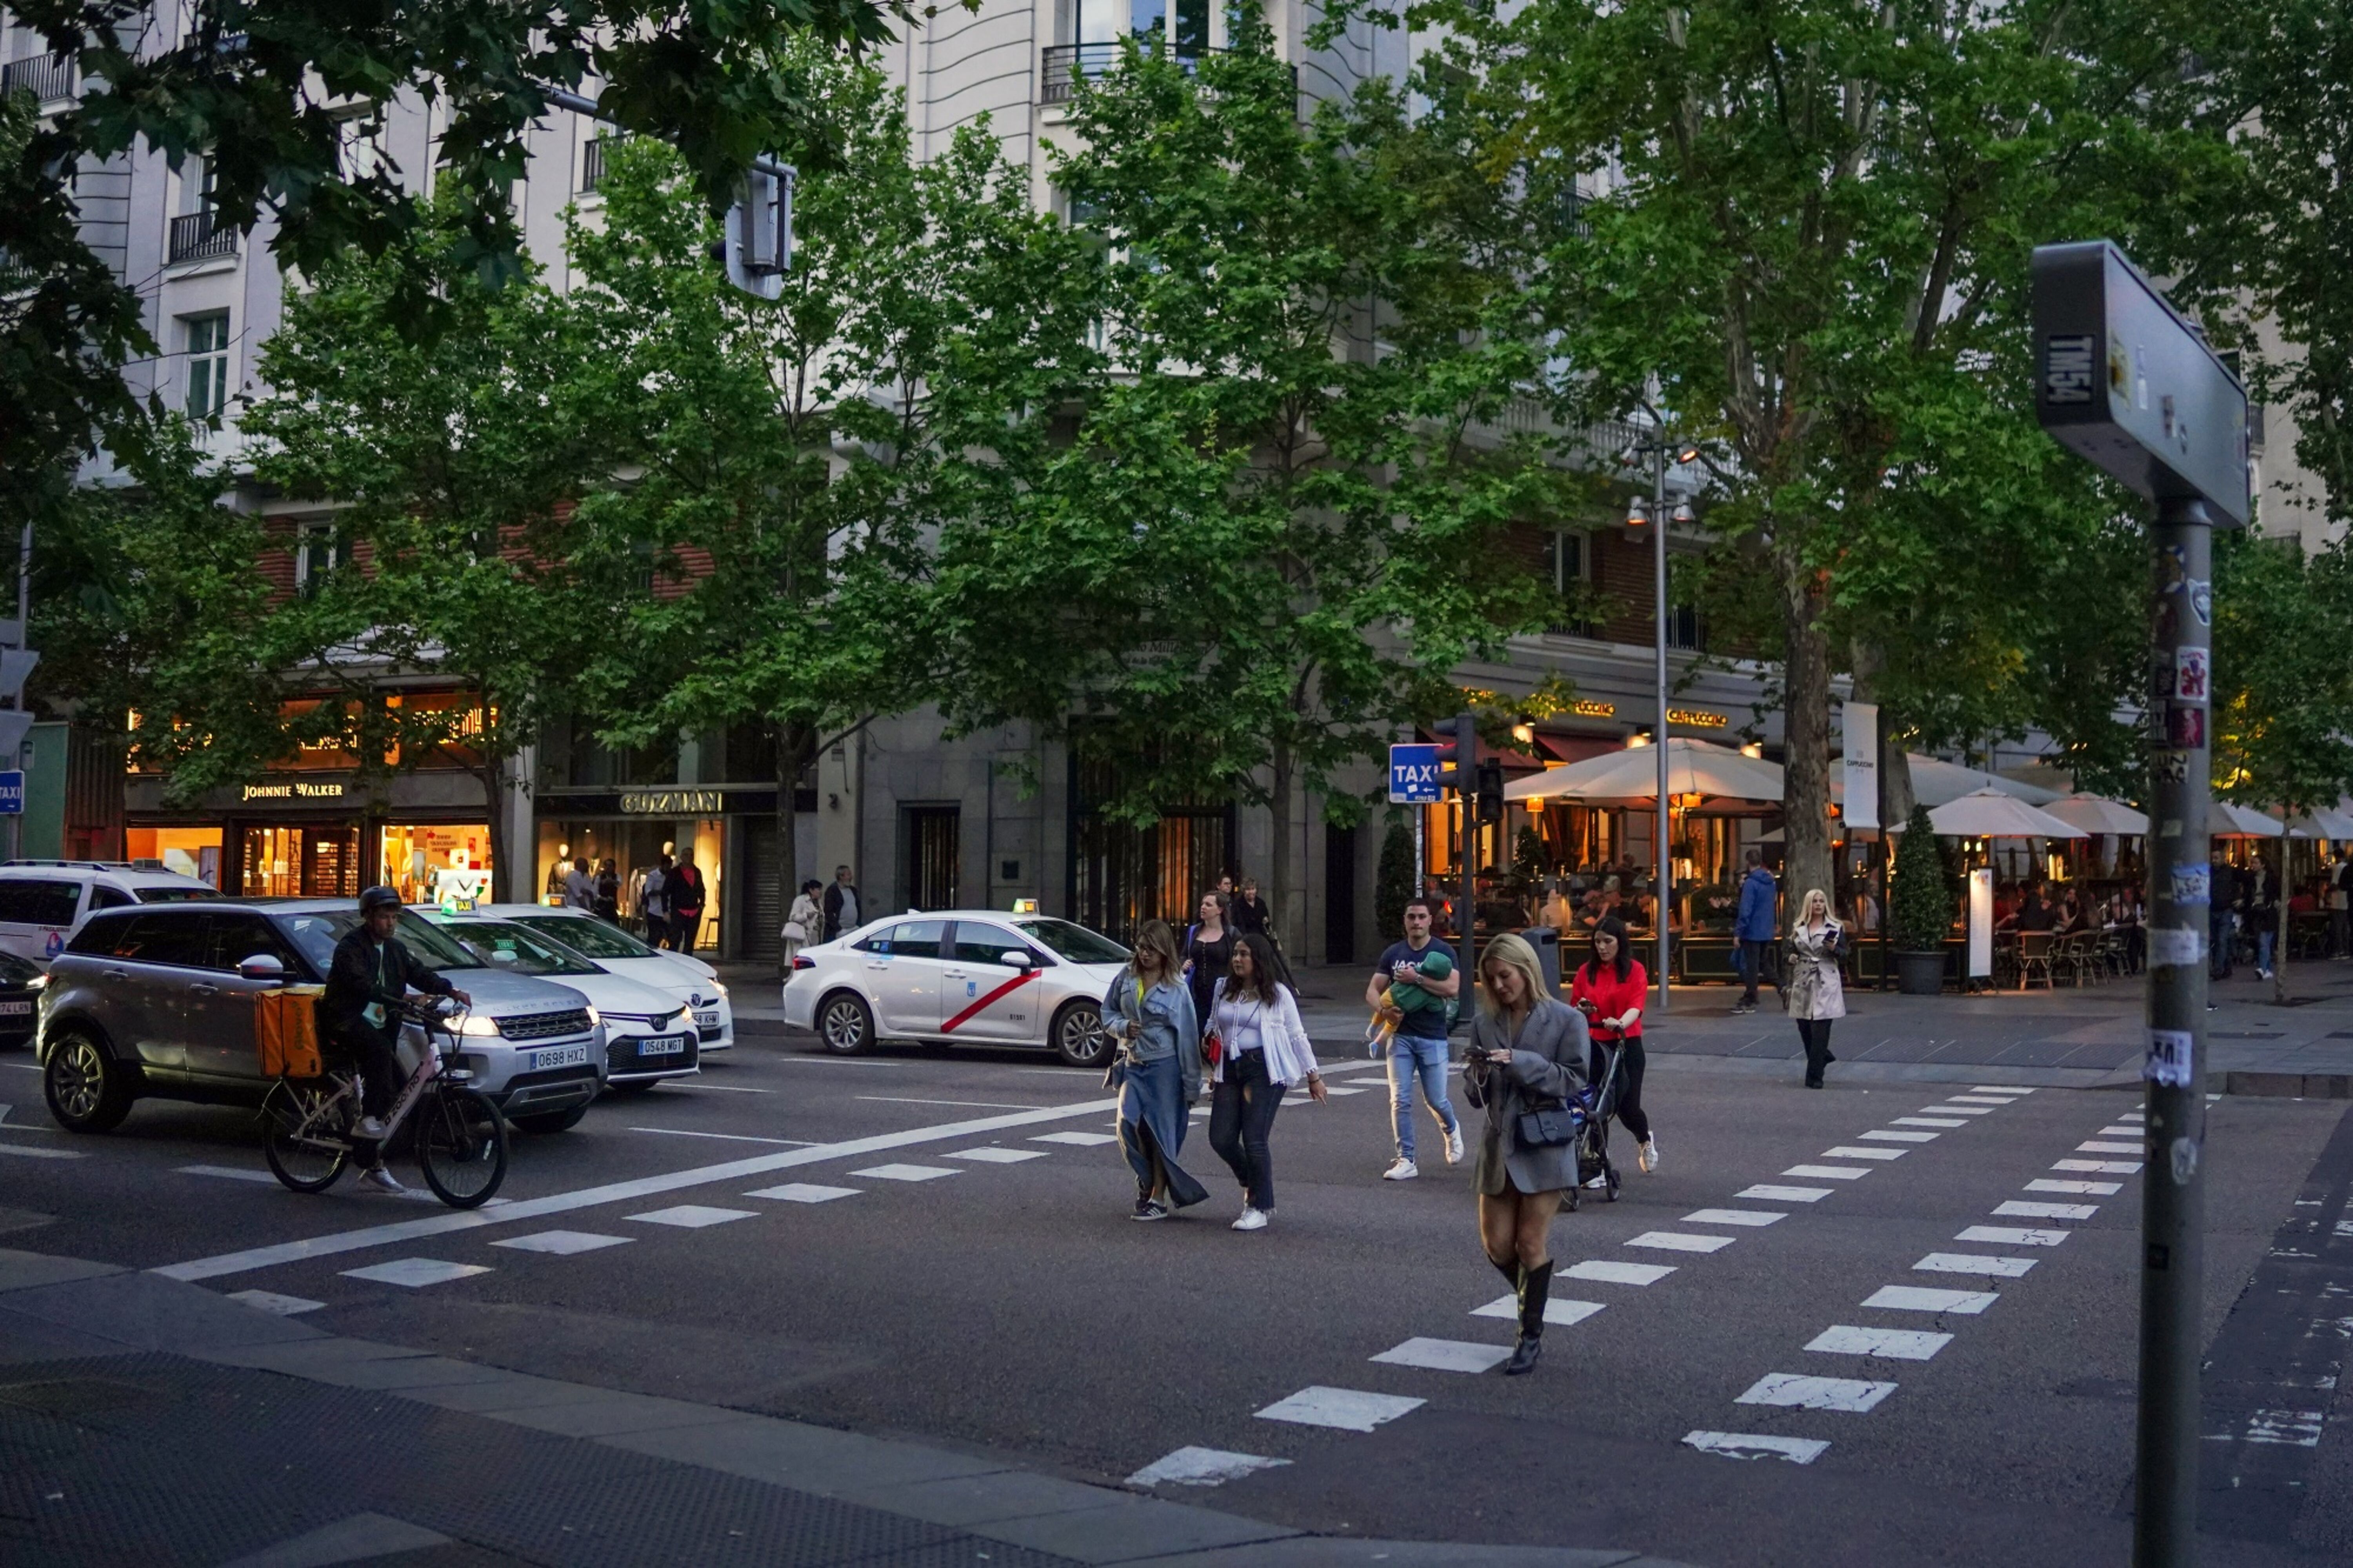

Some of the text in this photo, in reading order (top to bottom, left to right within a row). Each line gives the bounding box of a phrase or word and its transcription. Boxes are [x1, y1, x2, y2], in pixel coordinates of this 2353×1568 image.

[1667, 709, 1728, 726] CAPPUCCINO
[1847, 759, 1874, 769] CAPPUCCINO
[242, 783, 343, 801] JOHNNIE WALKER
[458, 901, 471, 910] TAXI
[645, 1039, 682, 1052] 0548 MGT
[539, 1048, 584, 1066] 0698 HXZ
